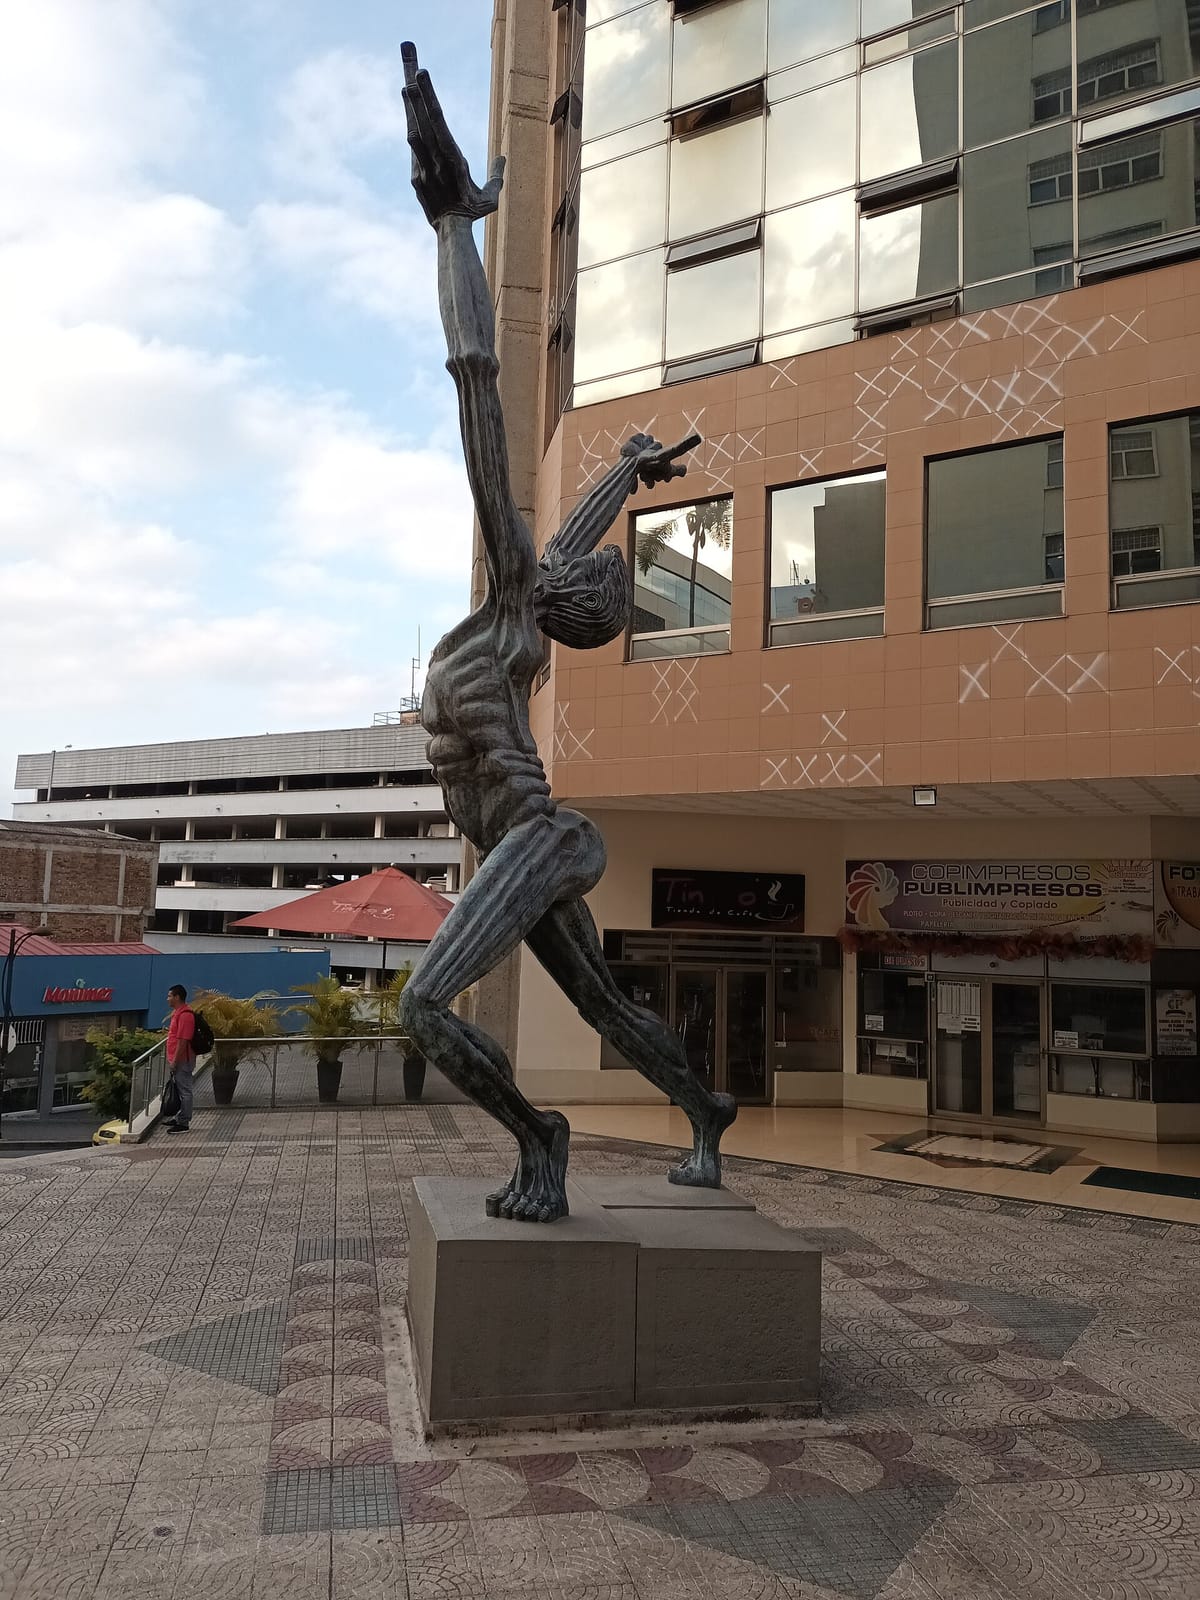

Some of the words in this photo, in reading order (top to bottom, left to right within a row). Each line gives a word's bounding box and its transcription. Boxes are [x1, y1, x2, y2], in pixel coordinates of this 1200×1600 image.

[911, 864, 1091, 881] COPIMPRESOS
[903, 881, 1103, 897] PUBLIMPRESOS
[942, 898, 998, 908] Publicidad
[1000, 901, 1007, 910] y
[1009, 899, 1059, 911] Copiado
